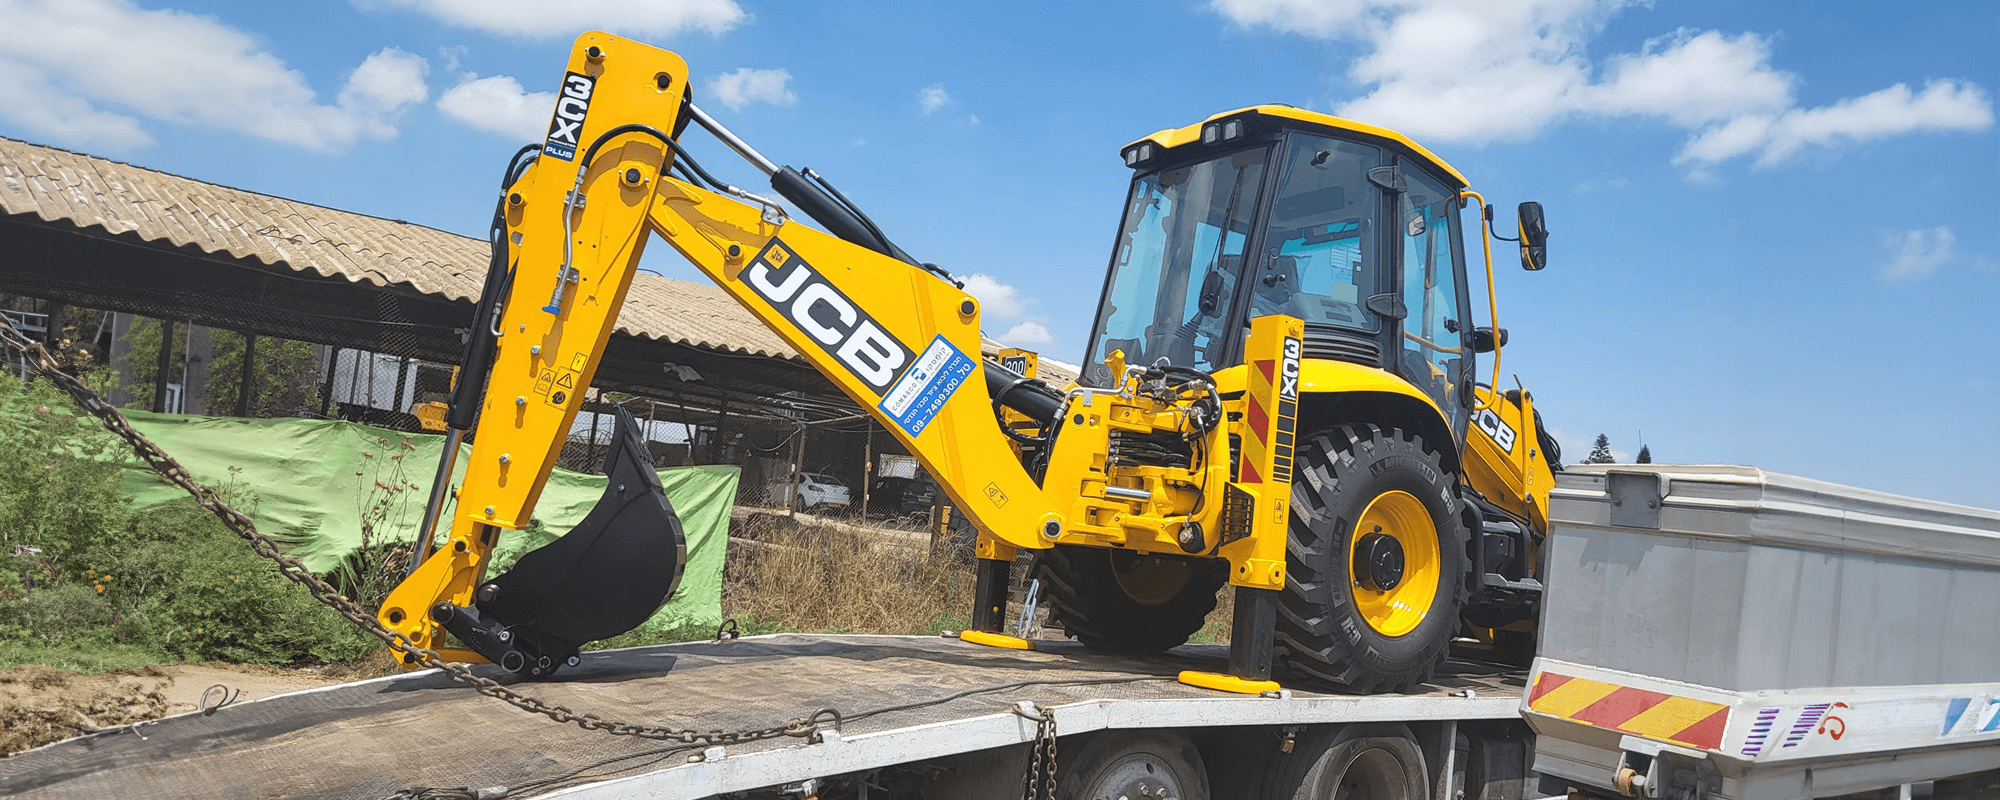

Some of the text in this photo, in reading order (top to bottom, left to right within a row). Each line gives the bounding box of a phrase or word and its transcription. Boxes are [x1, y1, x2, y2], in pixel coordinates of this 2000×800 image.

[549, 75, 592, 144] 3CX
[545, 146, 573, 159] PLUS
[749, 261, 905, 387] JCB
[925, 347, 946, 372] קומסקו
[948, 356, 963, 372] חברה
[1280, 338, 1300, 397] 3CX
[892, 382, 917, 411] COMASCO
[912, 377, 959, 432] 09-7499300
